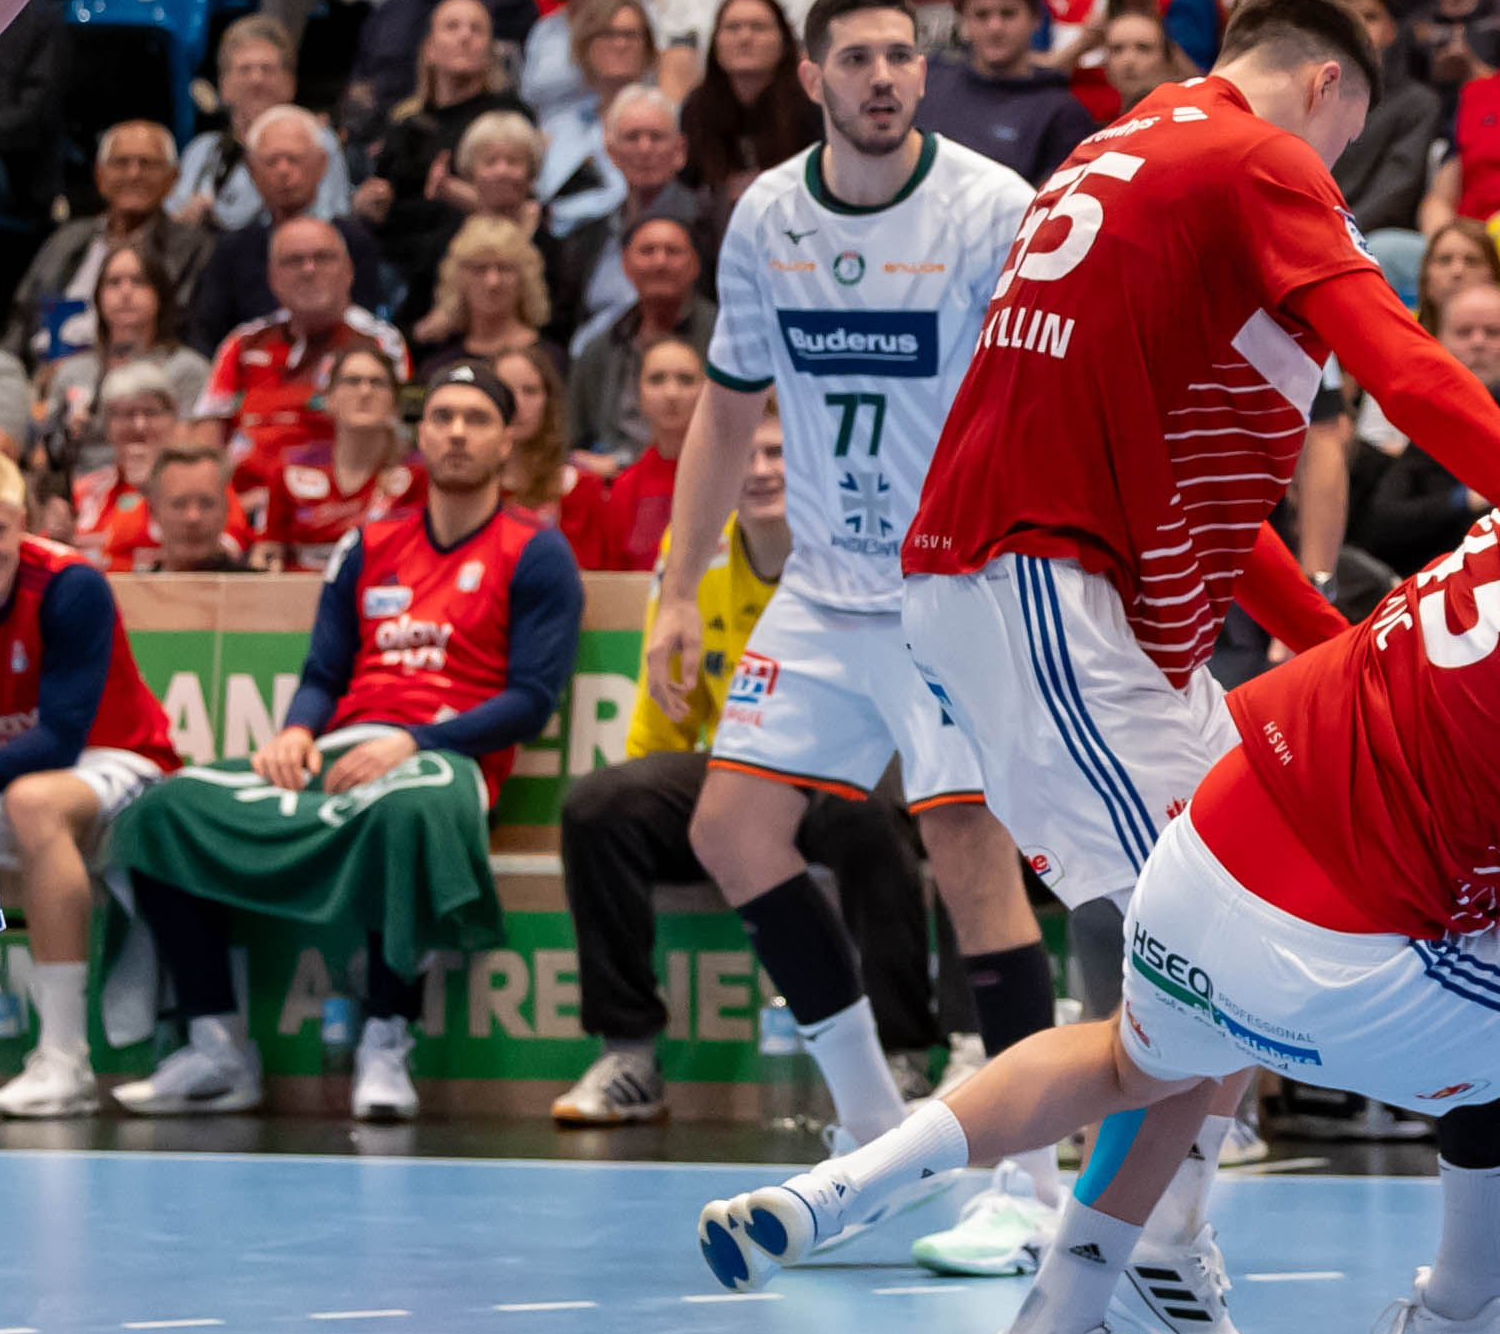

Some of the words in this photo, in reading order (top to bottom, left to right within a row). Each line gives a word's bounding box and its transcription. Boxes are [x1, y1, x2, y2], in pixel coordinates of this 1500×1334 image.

[787, 327, 919, 353] Buderus
[825, 392, 887, 457] 77
[913, 534, 952, 549] HSVH
[1263, 721, 1294, 766] HSVH
[1132, 921, 1214, 999] HSEQ
[1218, 992, 1316, 1044] PROFESSIONAL
